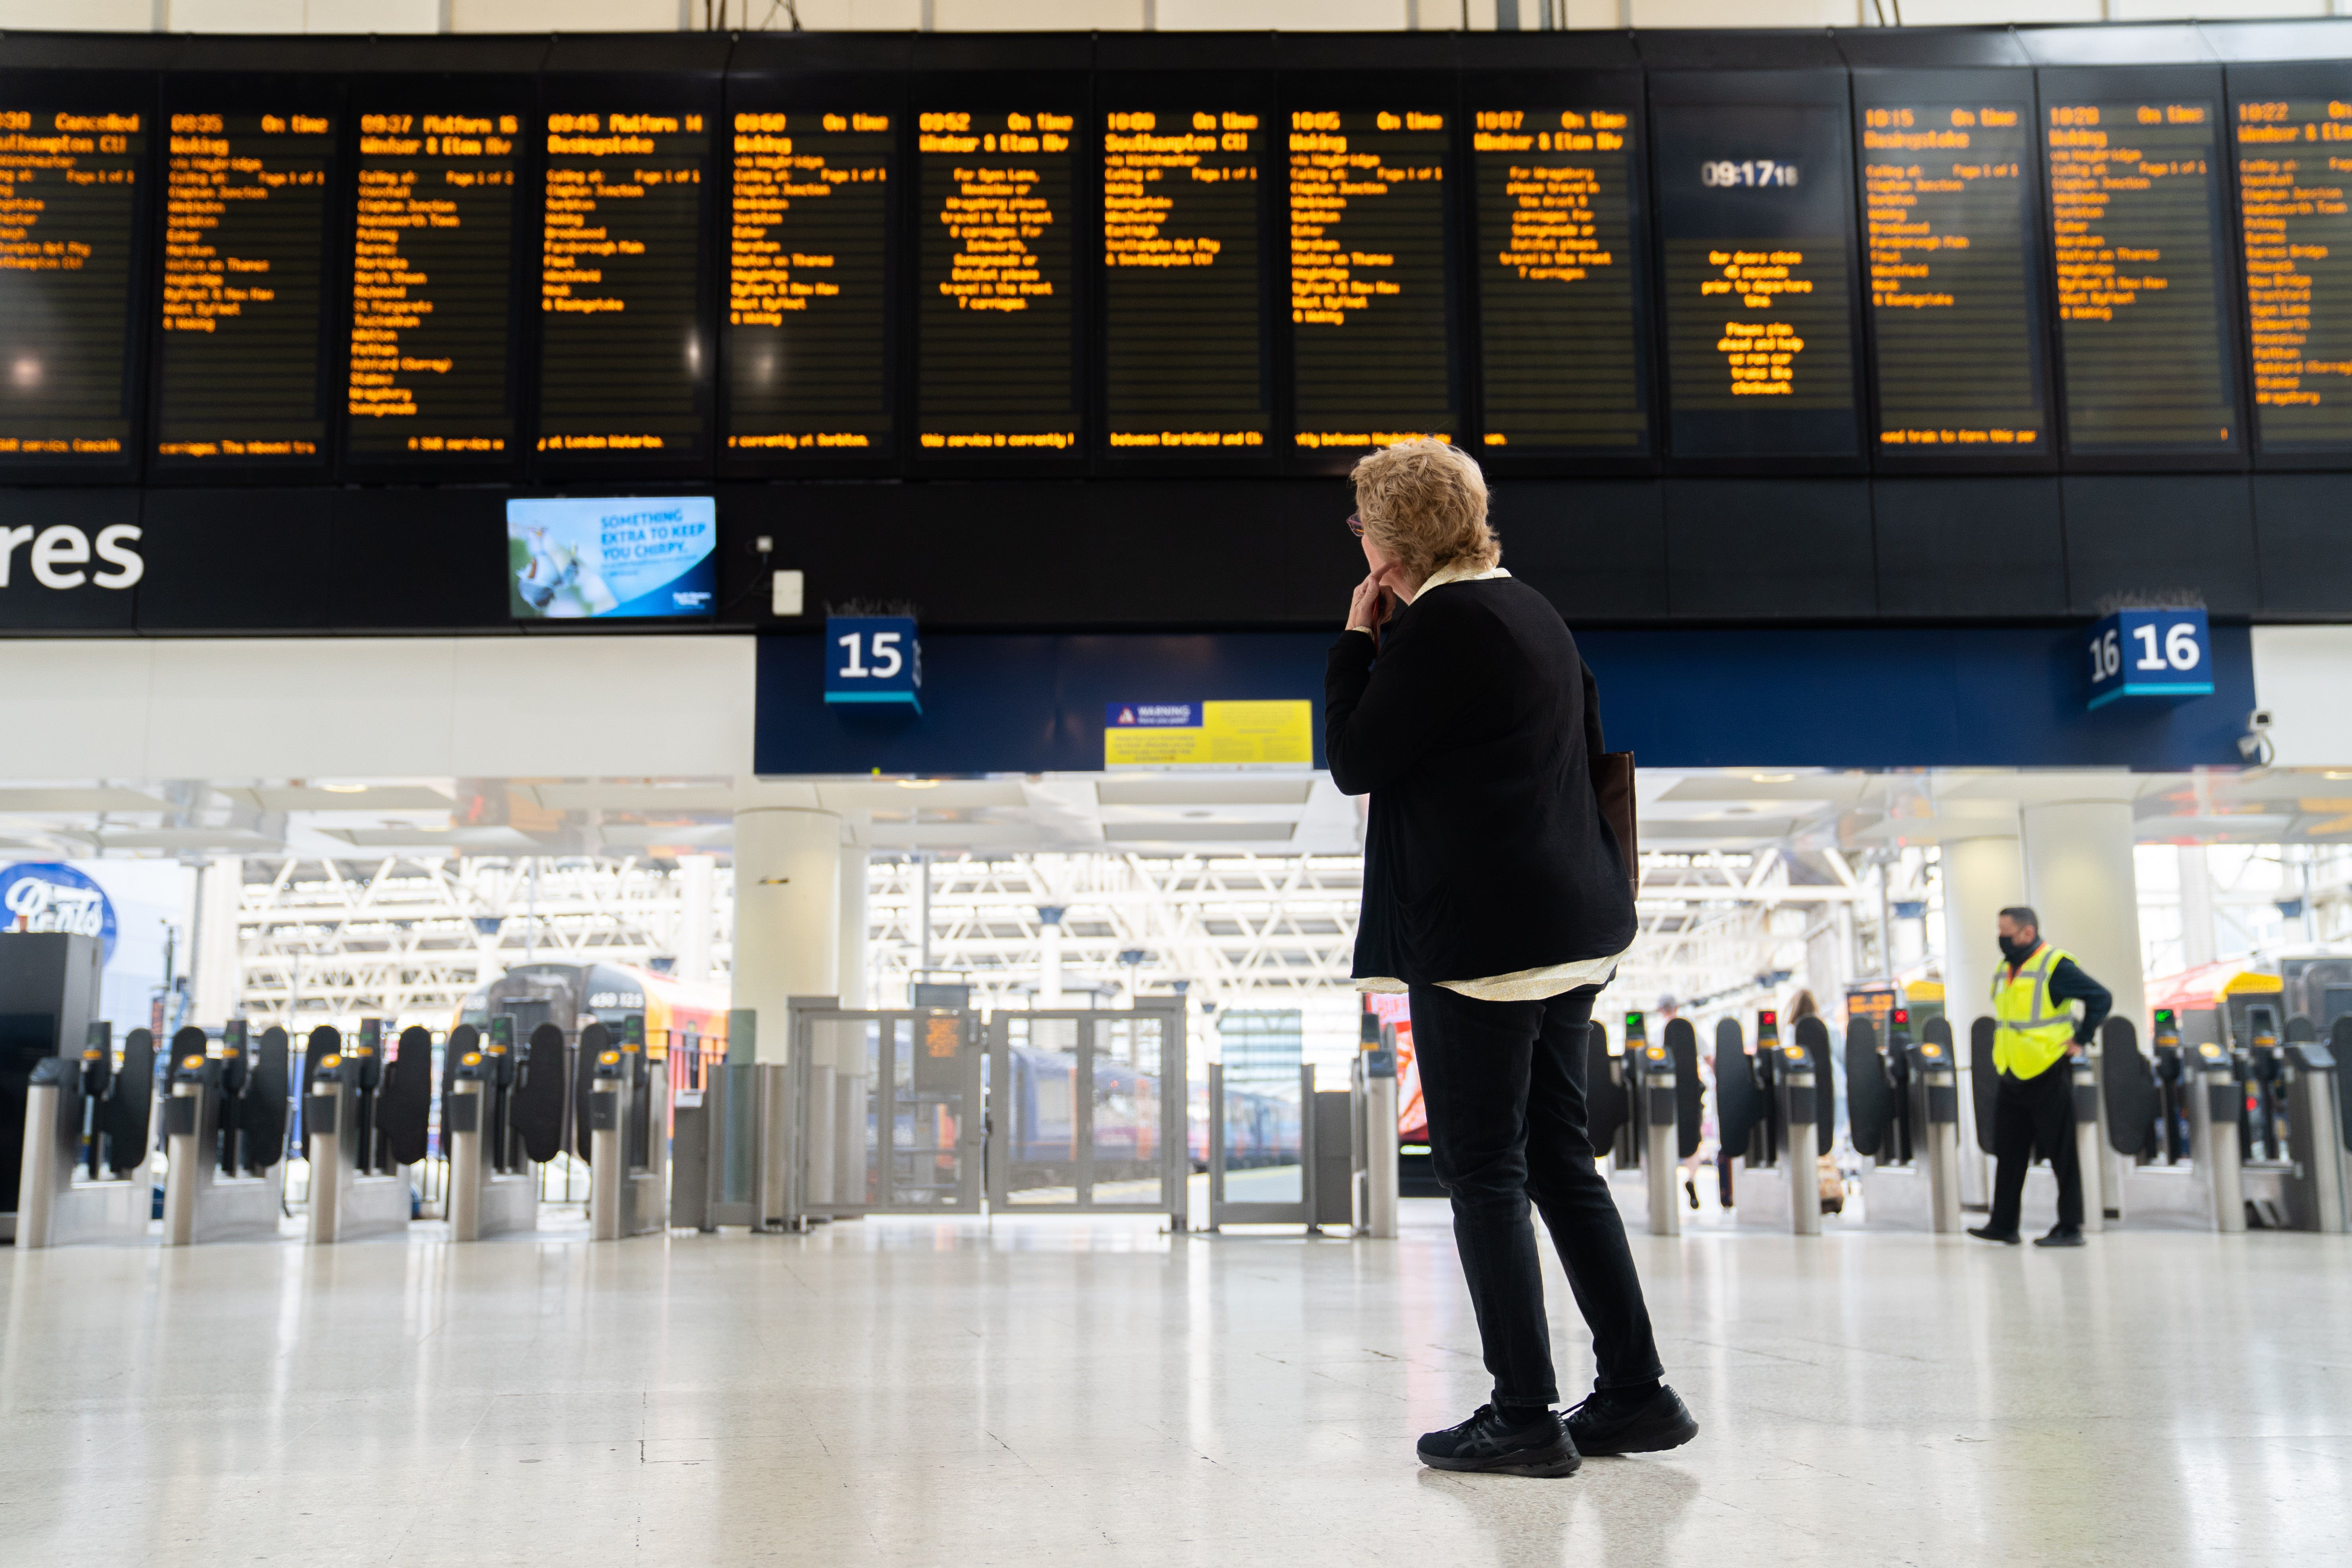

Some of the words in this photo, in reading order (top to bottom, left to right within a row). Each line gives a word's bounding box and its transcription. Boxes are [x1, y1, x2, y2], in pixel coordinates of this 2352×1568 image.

[54, 112, 140, 130] Cancelled
[262, 114, 286, 133] On
[291, 114, 328, 133] time
[423, 114, 493, 133] Platform
[609, 114, 679, 132] Platform
[823, 113, 847, 132] On
[852, 113, 889, 132] time
[1007, 113, 1032, 132] On
[1037, 113, 1073, 132] time
[1192, 112, 1217, 131] On
[1222, 112, 1258, 131] time
[1376, 111, 1401, 130] On
[1406, 111, 1443, 130] time
[1561, 111, 1586, 129] On
[1589, 111, 1626, 129] time
[1867, 109, 1912, 127] 10:15
[1952, 108, 1976, 127] On
[1979, 108, 2015, 127] time
[2138, 105, 2163, 124] On
[2165, 105, 2202, 124] time
[1864, 130, 1968, 152] Basingstoke
[2238, 124, 2300, 142] Windsor
[547, 135, 654, 156] Basingstoke
[602, 509, 683, 528] SOMETHING
[601, 528, 645, 545] EXTRA
[651, 526, 669, 539] TO
[671, 522, 706, 538] KEEP
[602, 546, 631, 561] YOU
[838, 632, 902, 678] 15
[2089, 628, 2120, 683] 16
[2133, 623, 2201, 671] 16
[1137, 705, 1191, 715] WARNING
[589, 992, 618, 1007] 450
